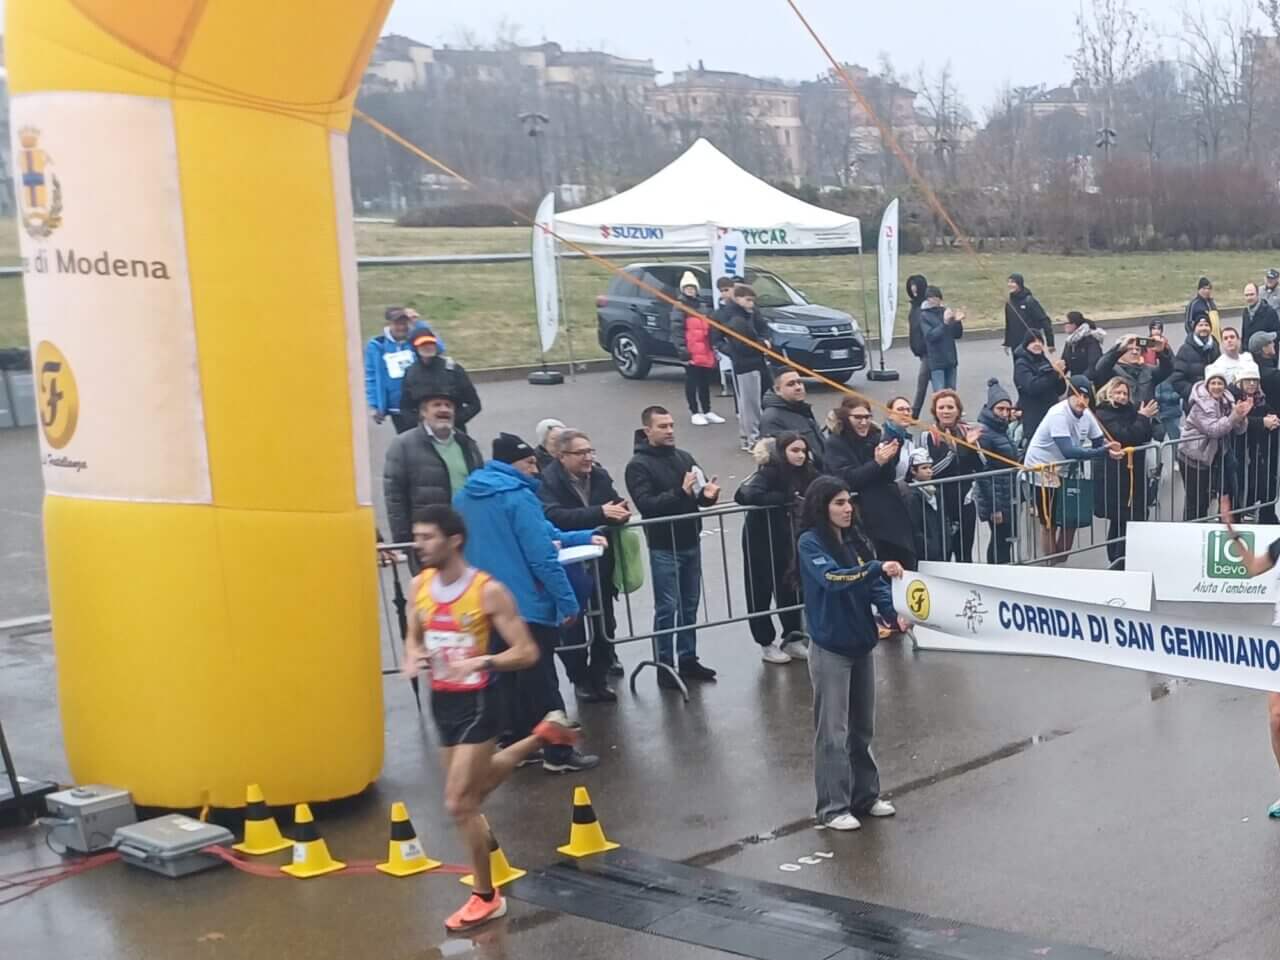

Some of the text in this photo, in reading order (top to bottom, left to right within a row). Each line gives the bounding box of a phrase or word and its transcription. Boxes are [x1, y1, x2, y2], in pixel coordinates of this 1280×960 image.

[612, 226, 664, 240] SUZUKI
[732, 228, 788, 245] RYCAR
[34, 250, 49, 273] di
[55, 249, 171, 280] Modena
[1213, 563, 1247, 576] bevo
[1193, 581, 1268, 595] Aiuta l'ambiente
[999, 600, 1280, 671] CORRIDA DI SAN GEMINIANO
